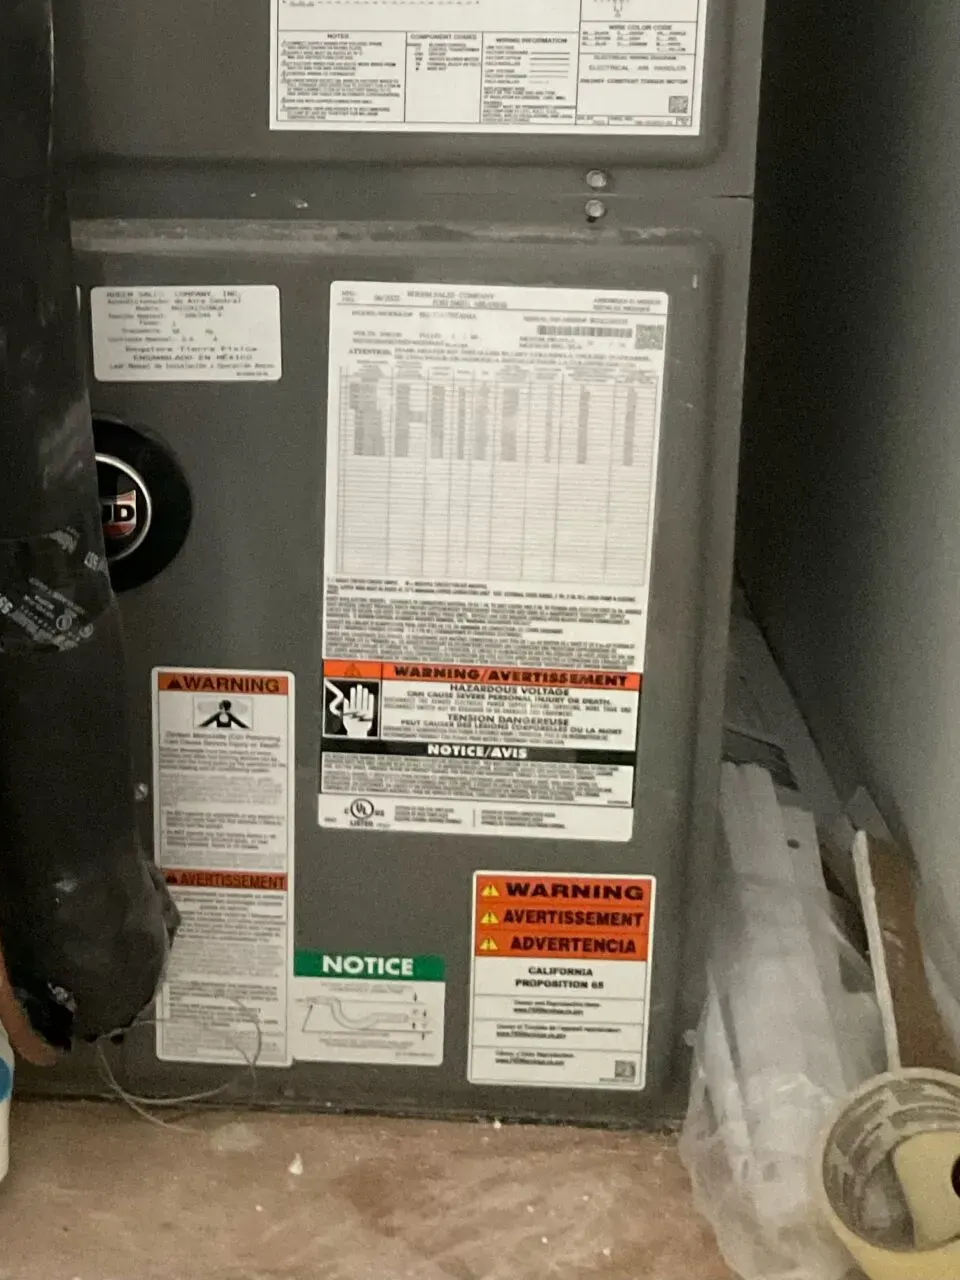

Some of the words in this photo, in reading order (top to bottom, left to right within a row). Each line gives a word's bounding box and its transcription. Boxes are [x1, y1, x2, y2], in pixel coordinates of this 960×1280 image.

[183, 675, 280, 693] WARNING
[450, 683, 517, 694] HAZARDOUS
[521, 686, 569, 696] VOLTAGE
[448, 713, 495, 722] TENSION
[498, 715, 569, 726] DANGEREUSE
[428, 744, 528, 759] NOTICE/AVIS
[180, 872, 285, 890] AVERTISSEMENT
[505, 882, 643, 901] WARNING
[504, 909, 643, 927] AVERTISSEMENT
[511, 936, 637, 953] ADVERTENCIA
[322, 954, 413, 976] NOTICE
[528, 967, 593, 977] CALIFORNIA
[515, 978, 588, 989] PROPOSITION
[591, 981, 605, 990] 65
